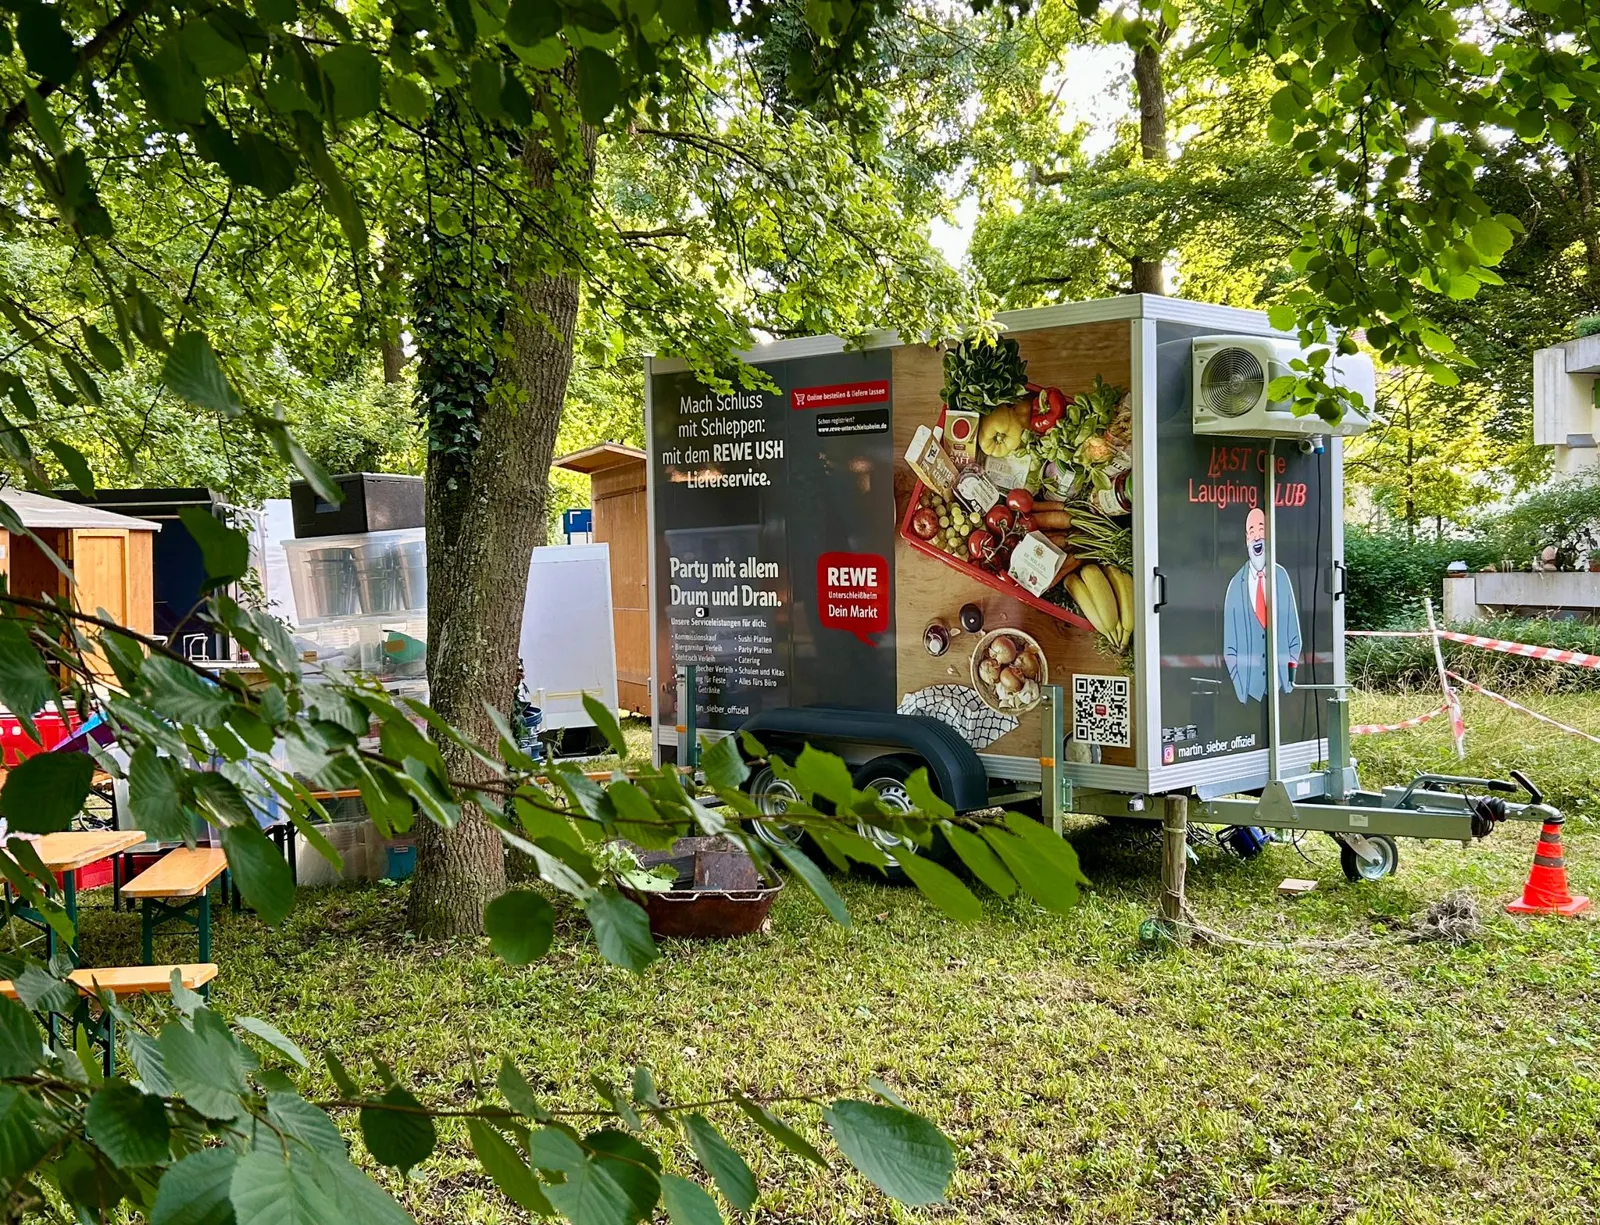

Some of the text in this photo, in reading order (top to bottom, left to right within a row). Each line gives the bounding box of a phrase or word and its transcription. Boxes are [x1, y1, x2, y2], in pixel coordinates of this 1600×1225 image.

[806, 387, 886, 402] Online bestellen & liefern lassen
[680, 391, 763, 414] Mach Schluss
[678, 416, 766, 439] mit Schleppen:
[662, 439, 784, 465] mit dem REWE USH
[1207, 446, 1287, 478] LAST Oe
[687, 467, 772, 489] Lieferservice.
[1188, 477, 1308, 509] Laughing LUB
[669, 556, 779, 584] Party mit allem
[827, 567, 878, 587] REWE
[669, 584, 782, 608] Drum und Dran.
[828, 590, 878, 600] Unterschleißheim
[828, 603, 878, 619] Dein Markt
[670, 617, 767, 629] Unsere Serviceleistungen für dich:
[737, 634, 772, 644] Sushi Platten
[704, 644, 723, 653] Verleih
[738, 645, 773, 655] Party Platten
[738, 656, 760, 666] Catering
[714, 665, 734, 675] Verleih
[738, 666, 785, 677] Schulen und Kitas
[712, 675, 726, 685] Feste
[738, 678, 777, 688] Alles fürs Büro
[696, 704, 749, 715] tin_sieber_offiziell
[1178, 734, 1256, 757] martin_sieber_offiziell
